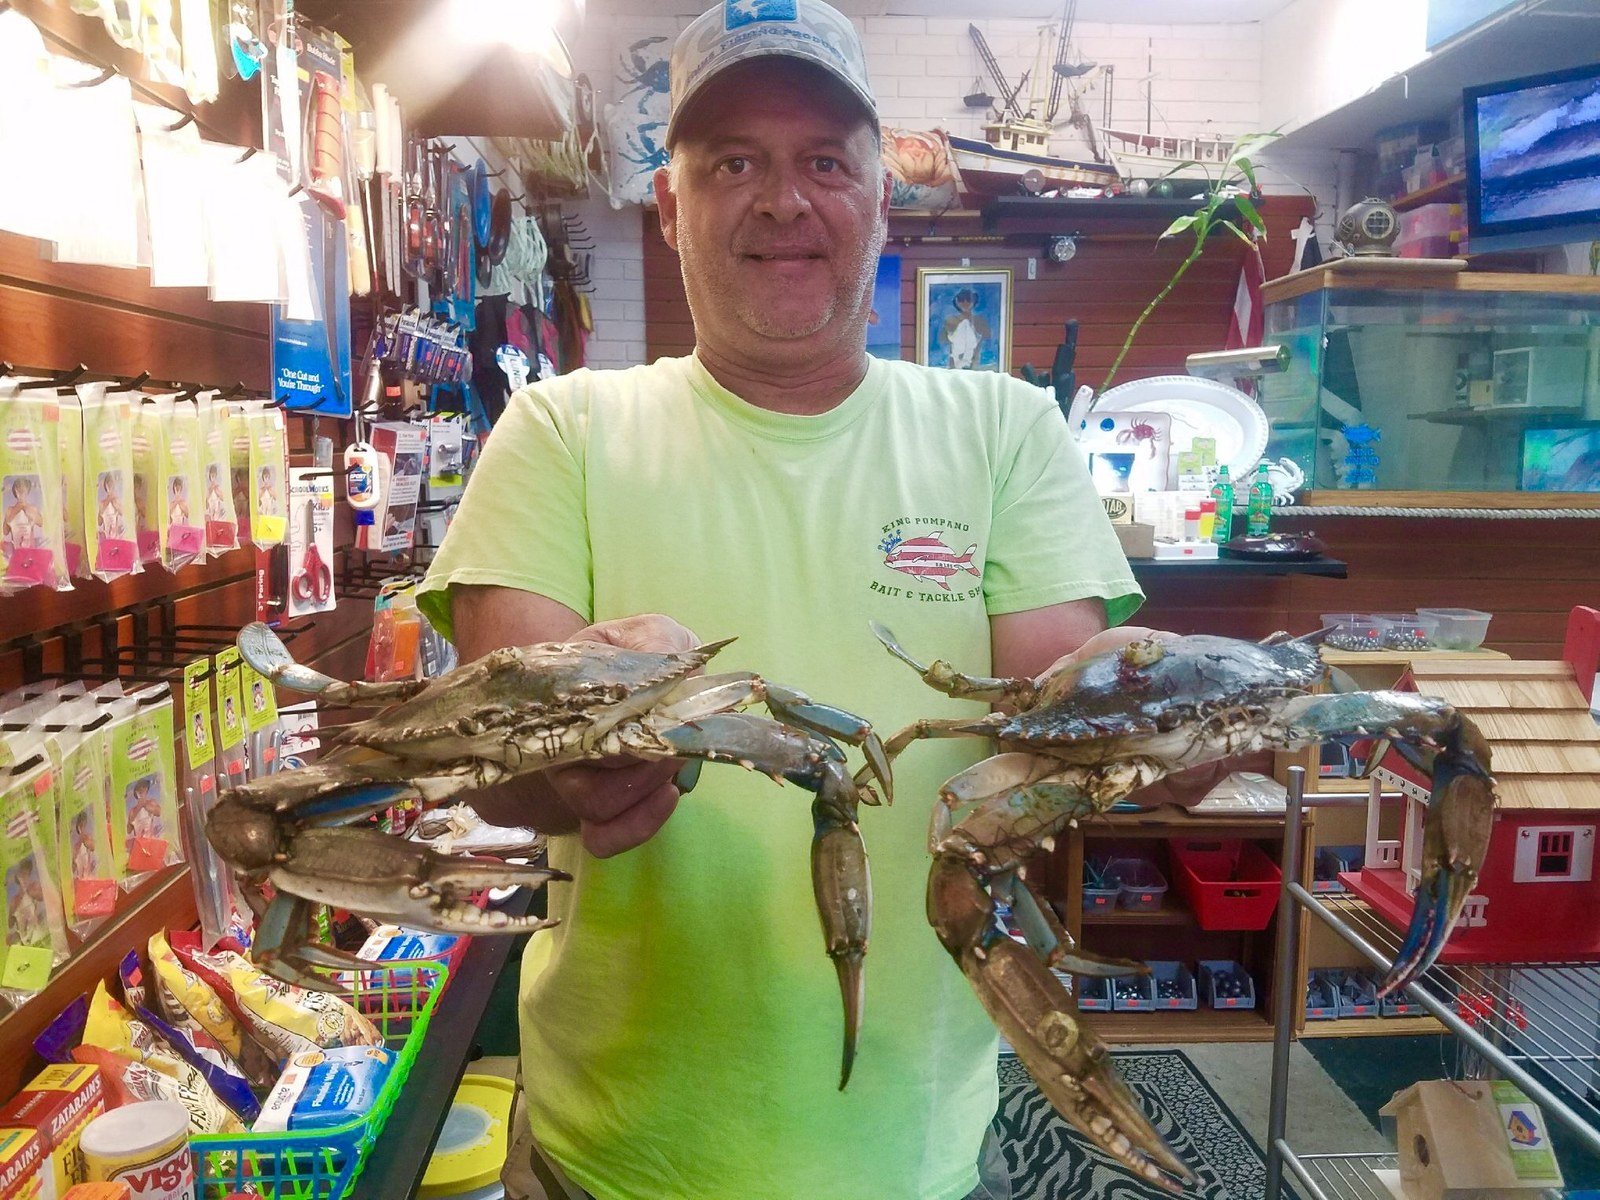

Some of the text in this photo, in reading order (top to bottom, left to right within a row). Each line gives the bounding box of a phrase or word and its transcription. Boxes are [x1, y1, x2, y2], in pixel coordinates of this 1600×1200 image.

[297, 370, 308, 381] Cut
[308, 373, 320, 383] and
[881, 517, 970, 534] KING POMPANO
[869, 580, 902, 597] BAIT
[918, 592, 966, 602] TACKLE
